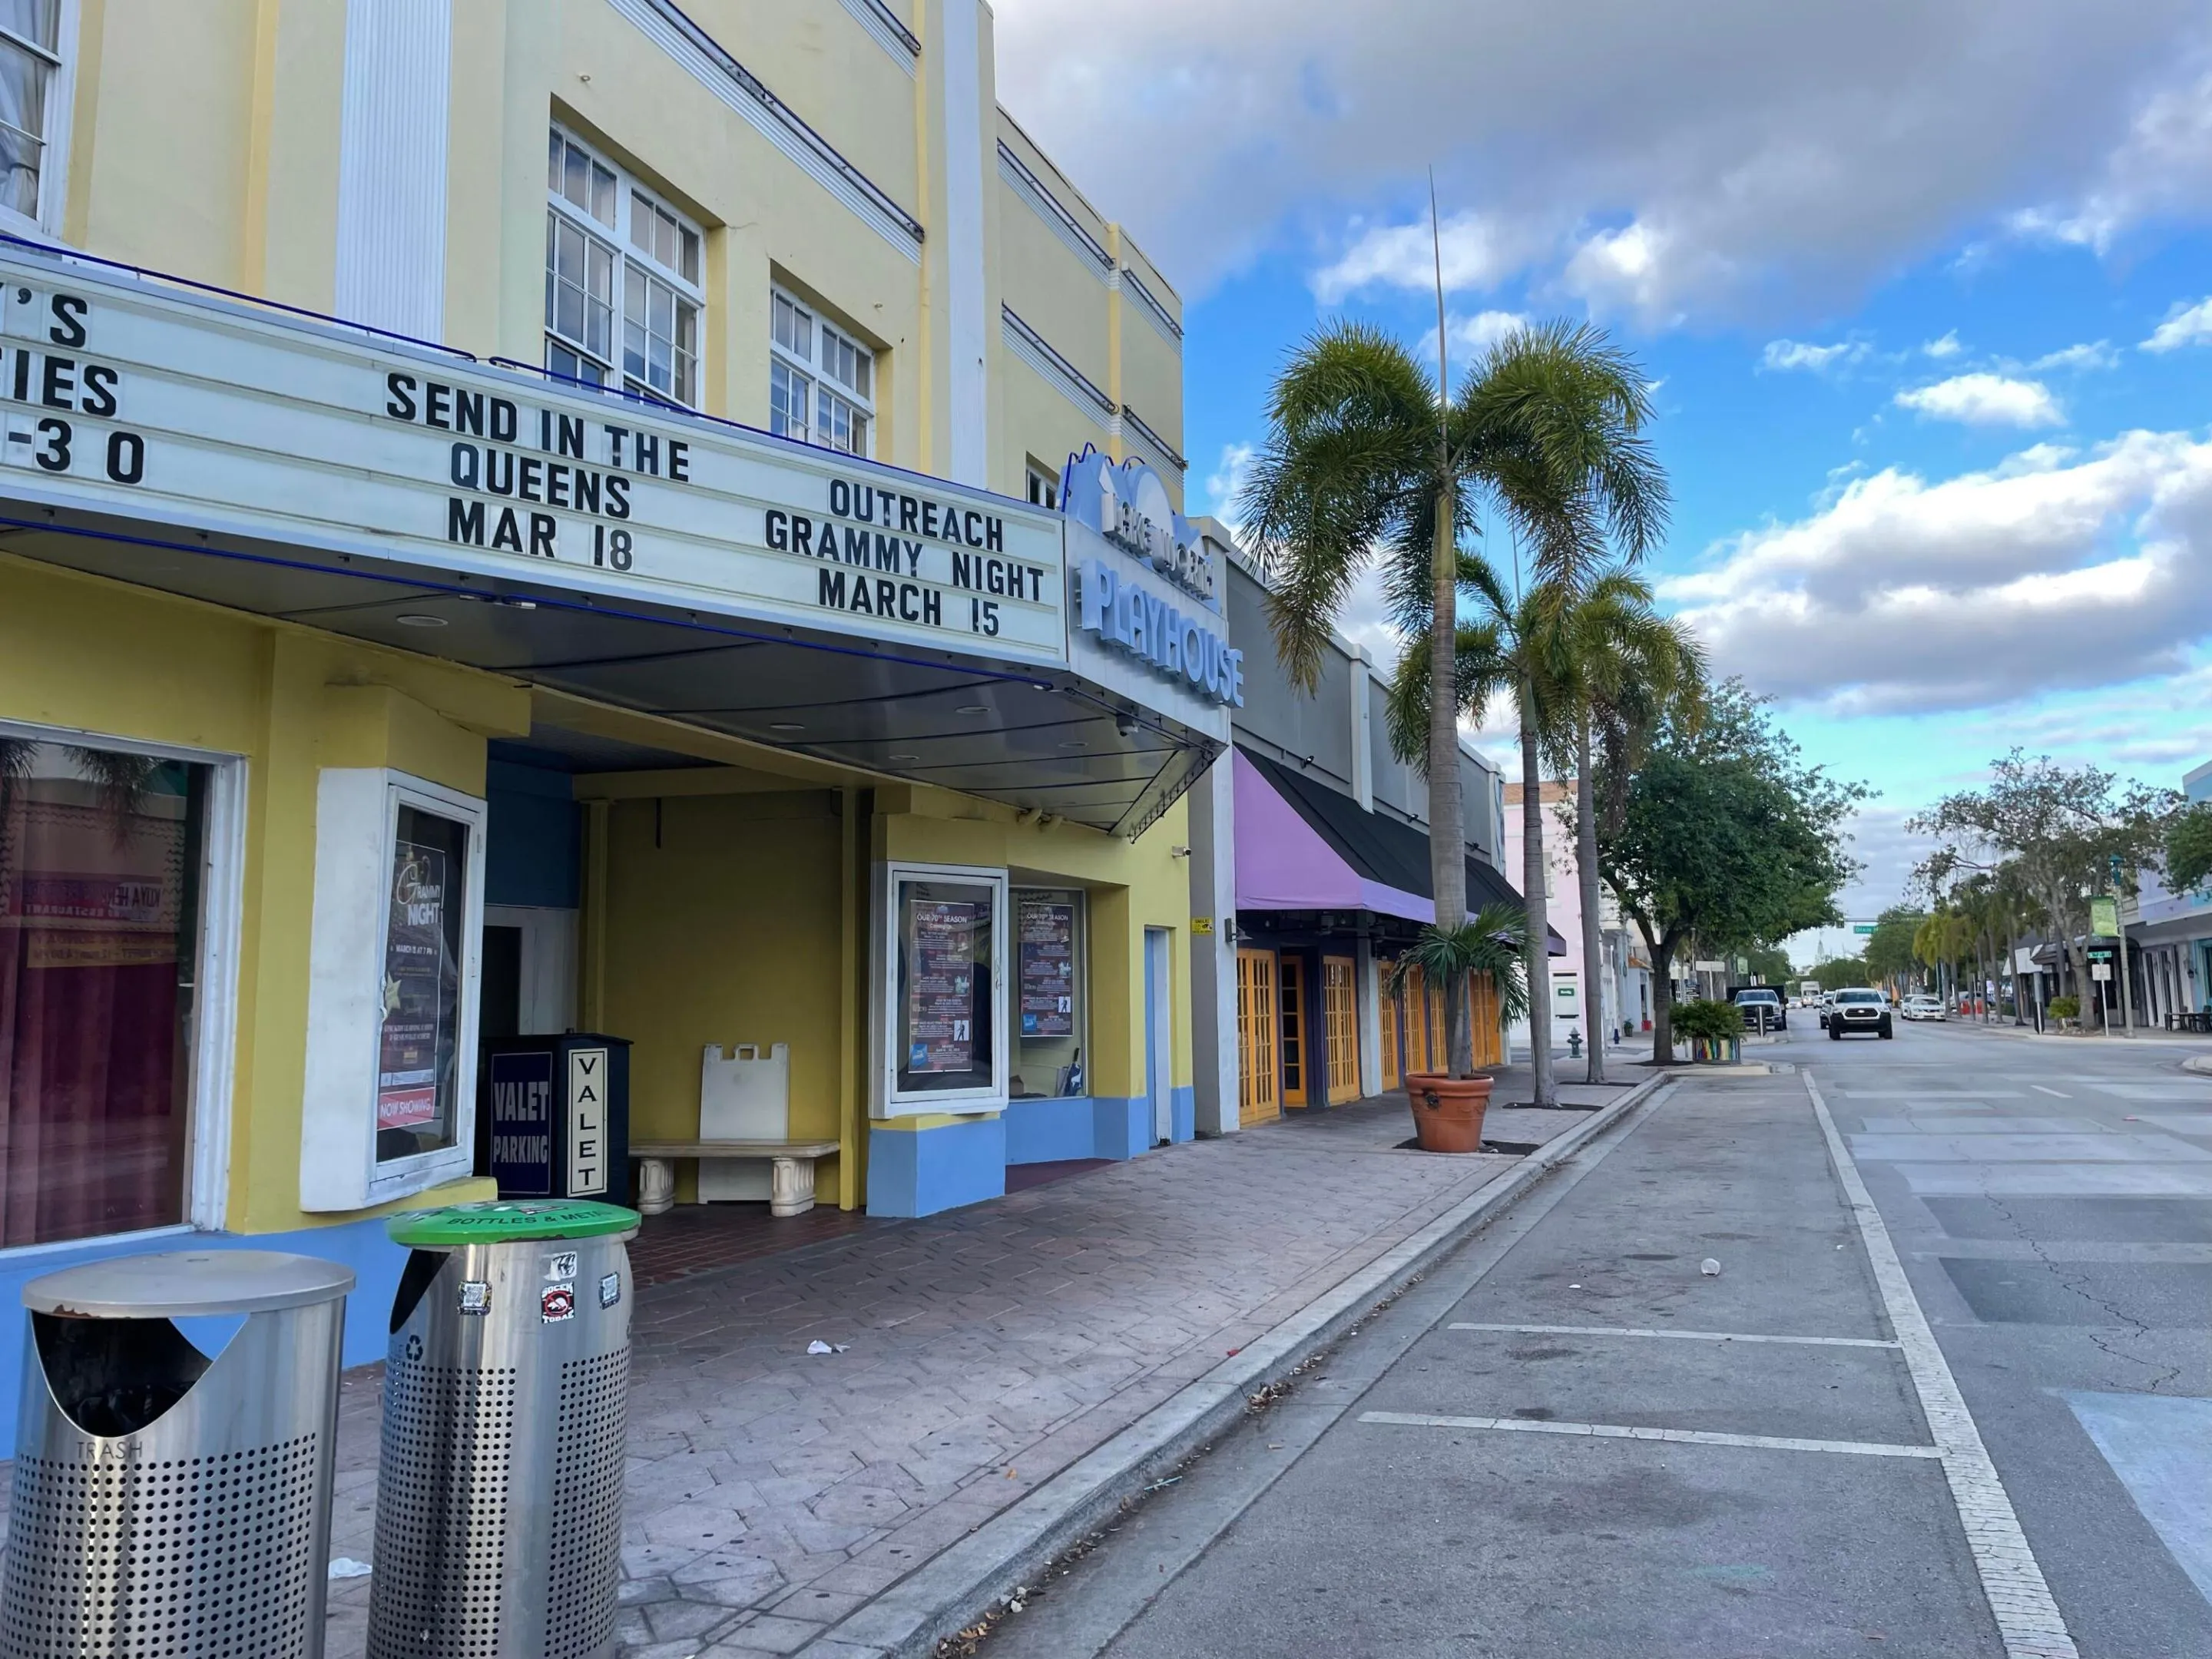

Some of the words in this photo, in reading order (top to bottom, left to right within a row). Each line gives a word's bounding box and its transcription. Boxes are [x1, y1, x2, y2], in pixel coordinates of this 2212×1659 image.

[0, 283, 88, 349] 'S
[0, 349, 118, 418] IES
[387, 373, 517, 442] SEND
[541, 409, 584, 459] IN
[604, 426, 689, 482] THE
[451, 442, 631, 519] QUEENS
[449, 498, 556, 558] MAR
[594, 525, 634, 571] 18
[830, 478, 1003, 553] OUTREACH
[1101, 492, 1152, 556] LAKE
[1152, 525, 1214, 601] WORTH
[765, 509, 923, 578] GRAMMY
[952, 551, 1044, 601] NIGHT
[819, 568, 942, 627] MARCH
[972, 598, 999, 637] 15
[1081, 558, 1243, 708] PLAYHOUSE
[396, 863, 441, 905] GRAMMY
[407, 902, 441, 927] NIGHT
[917, 912, 930, 922] OUR
[944, 915, 967, 923] SEASON
[381, 1101, 399, 1118] NOW
[399, 1098, 431, 1115] SHOWING
[493, 1081, 549, 1121] VALET
[578, 1057, 598, 1186] VALET
[492, 1135, 548, 1164] PARKING
[447, 1216, 537, 1225] BOTTLES
[77, 1442, 142, 1459] TRASH
